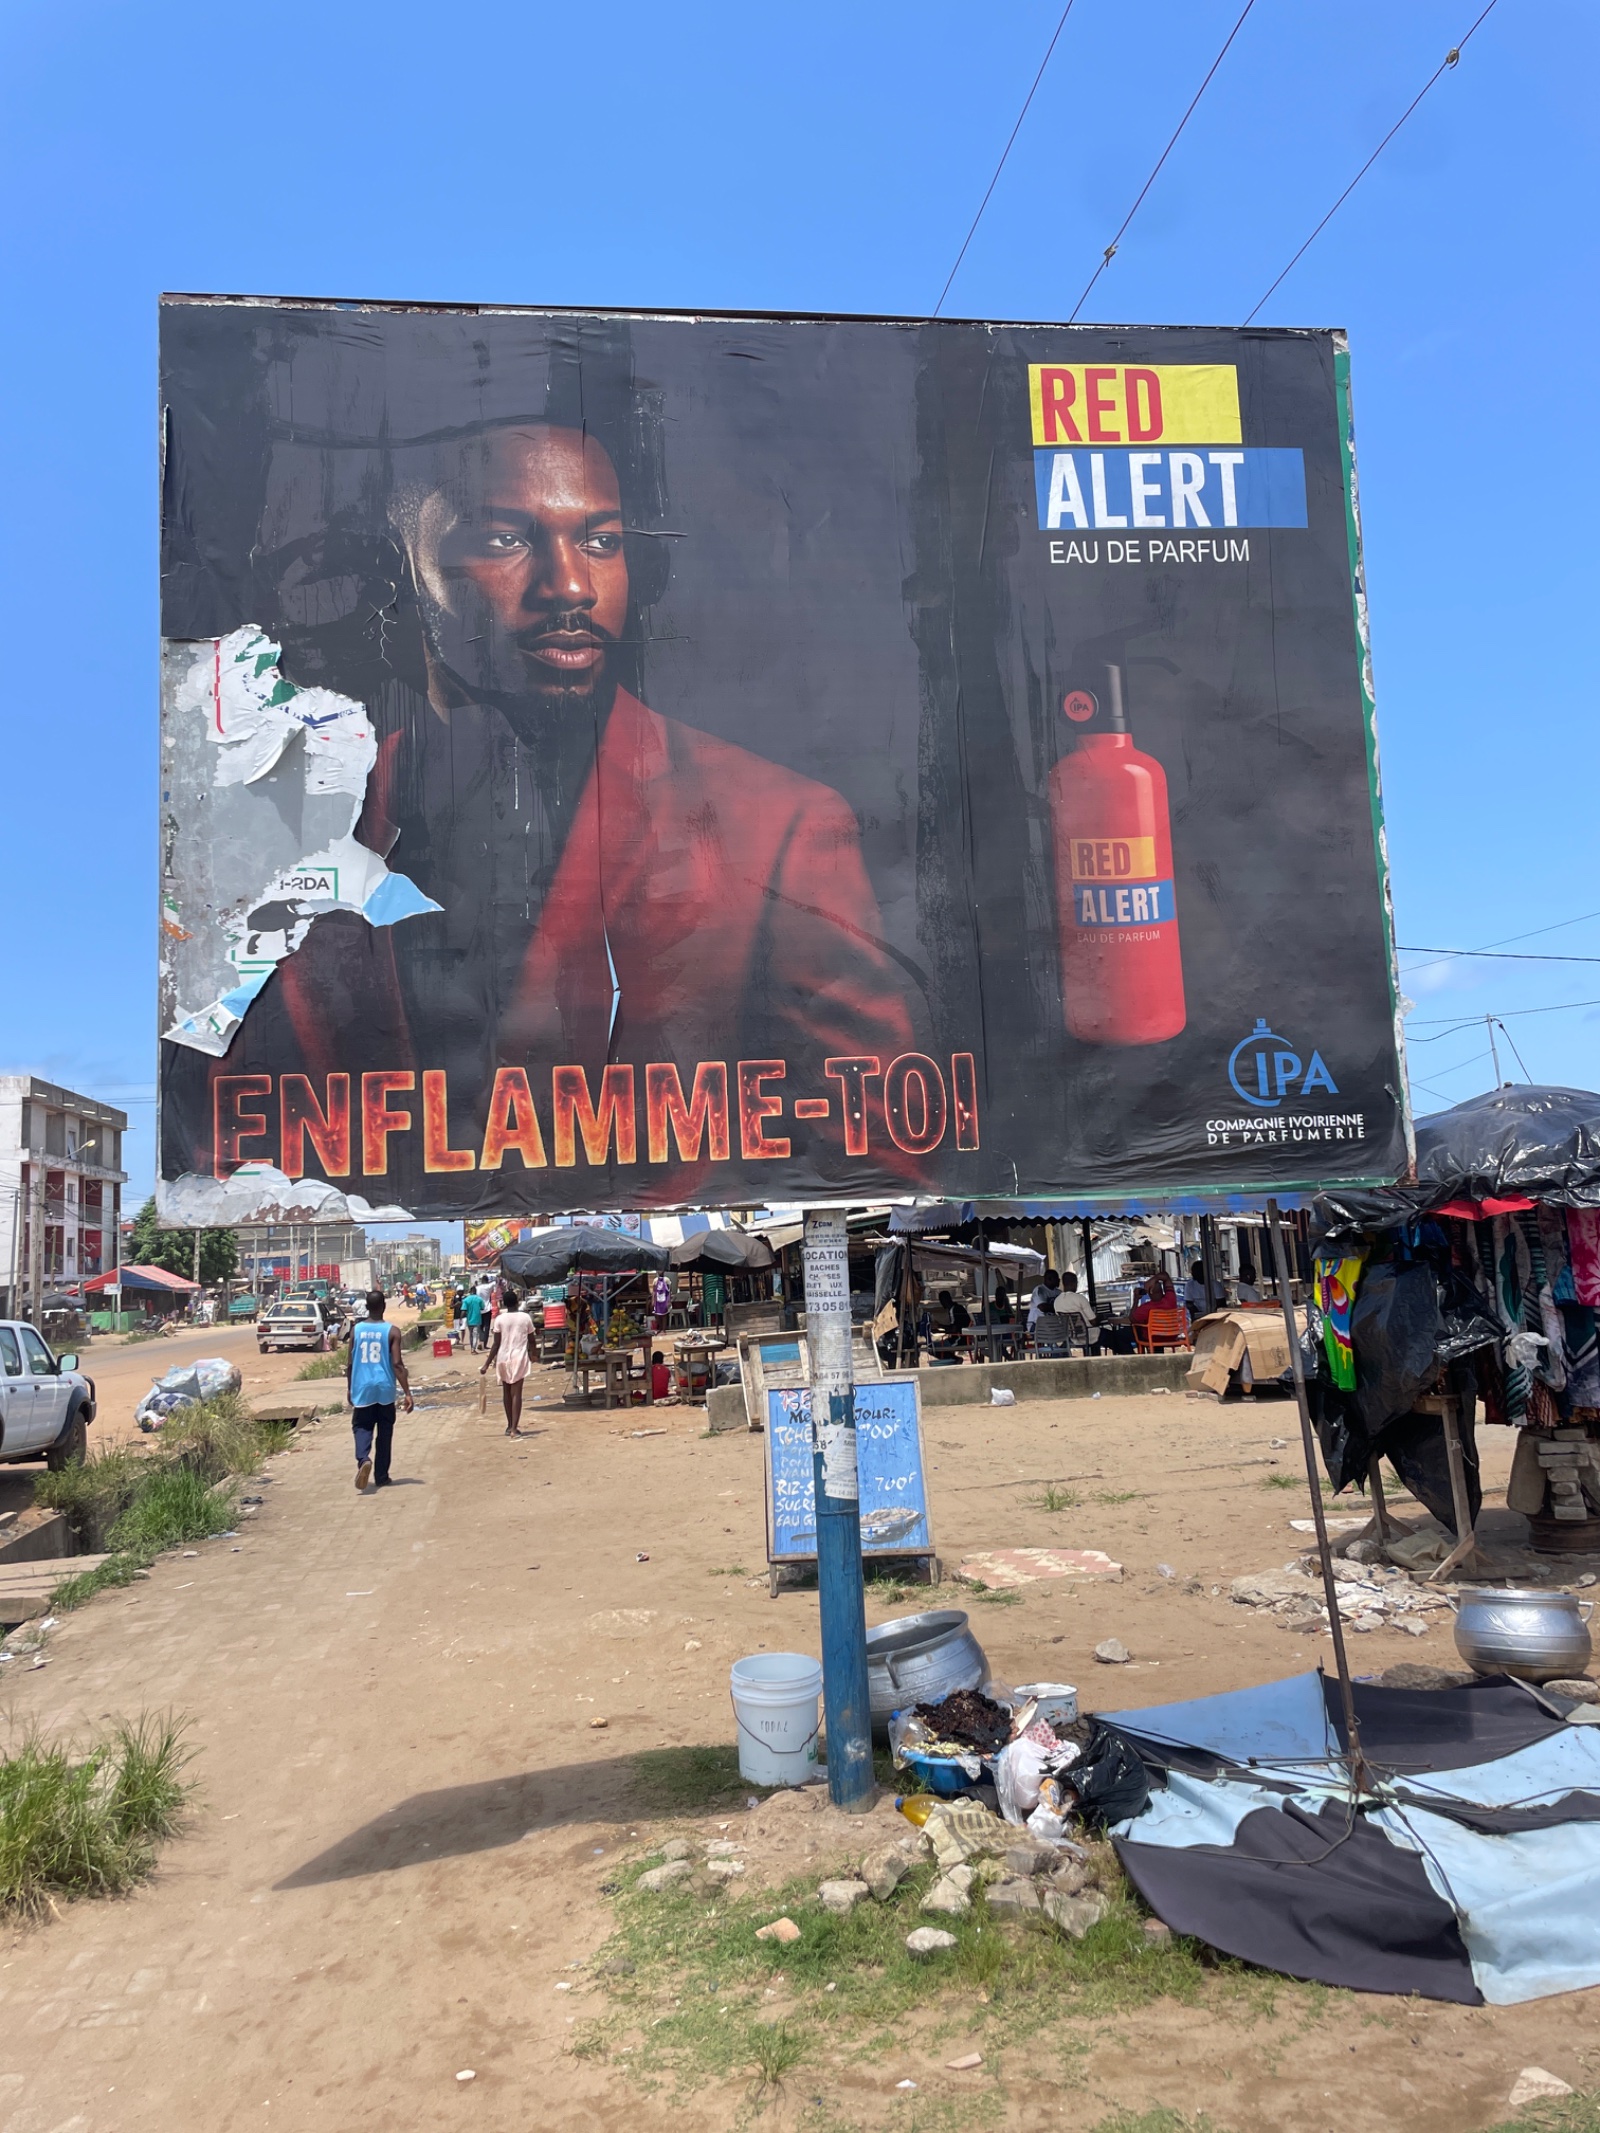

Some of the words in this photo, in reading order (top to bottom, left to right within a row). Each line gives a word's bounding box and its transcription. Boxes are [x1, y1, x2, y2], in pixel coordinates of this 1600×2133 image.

[1040, 367, 1164, 443] RED
[1046, 452, 1245, 529] ALERT
[1050, 541, 1098, 564] EAU
[1107, 540, 1141, 563] DE
[1149, 539, 1250, 563] PARFUM
[1076, 842, 1132, 876] RED
[1081, 886, 1160, 923] ALERT
[1077, 933, 1096, 943] EAU
[1100, 932, 1115, 943] DE
[1118, 930, 1161, 942] PARFUM
[213, 1052, 981, 1182] ENFLAMME-TOI
[1206, 1116, 1286, 1132] COMPAGNIE
[1289, 1113, 1365, 1129] IVOIRIENNE
[1208, 1132, 1231, 1145] DE
[1243, 1127, 1366, 1143] PARFUMERIE
[360, 1341, 382, 1364] 18
